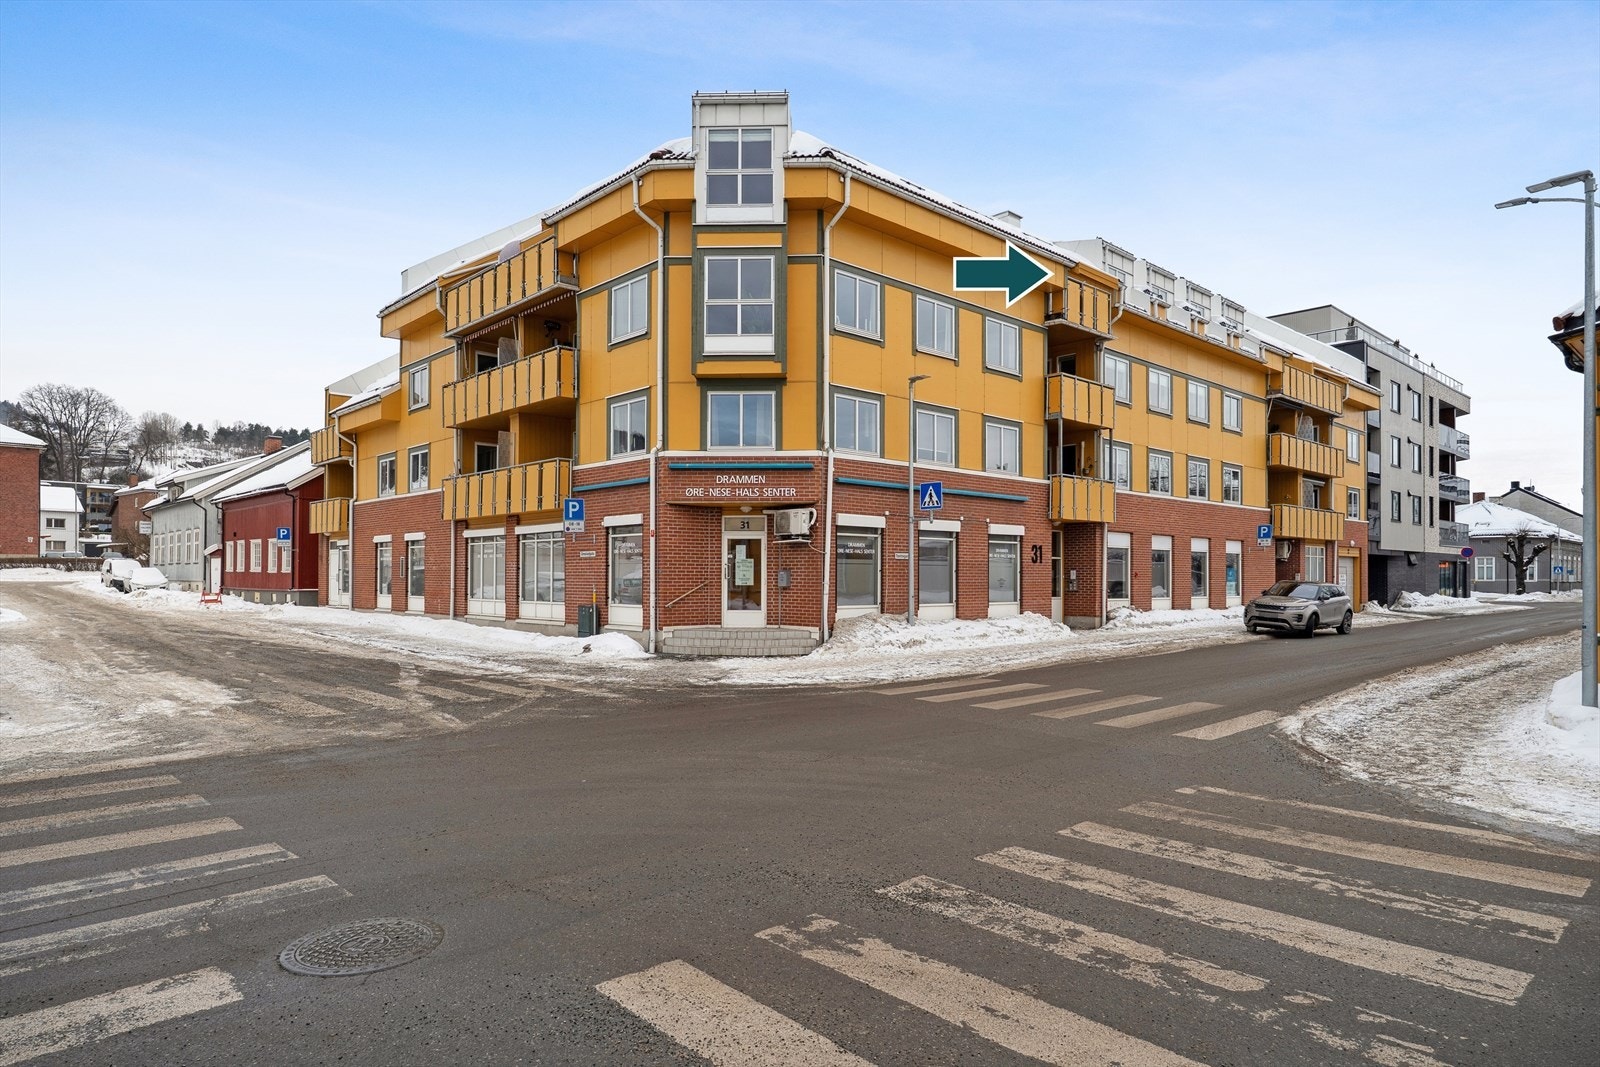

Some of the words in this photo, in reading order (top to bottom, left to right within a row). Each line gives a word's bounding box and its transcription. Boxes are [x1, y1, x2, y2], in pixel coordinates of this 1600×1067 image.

[716, 475, 765, 484] DRAMMEN
[685, 487, 760, 497] ØRE-NESE-HALS
[763, 487, 797, 497] SENTER
[569, 501, 580, 518] P
[740, 521, 750, 529] 31
[280, 529, 288, 539] P
[1260, 526, 1268, 537] P
[1031, 544, 1043, 564] 31
